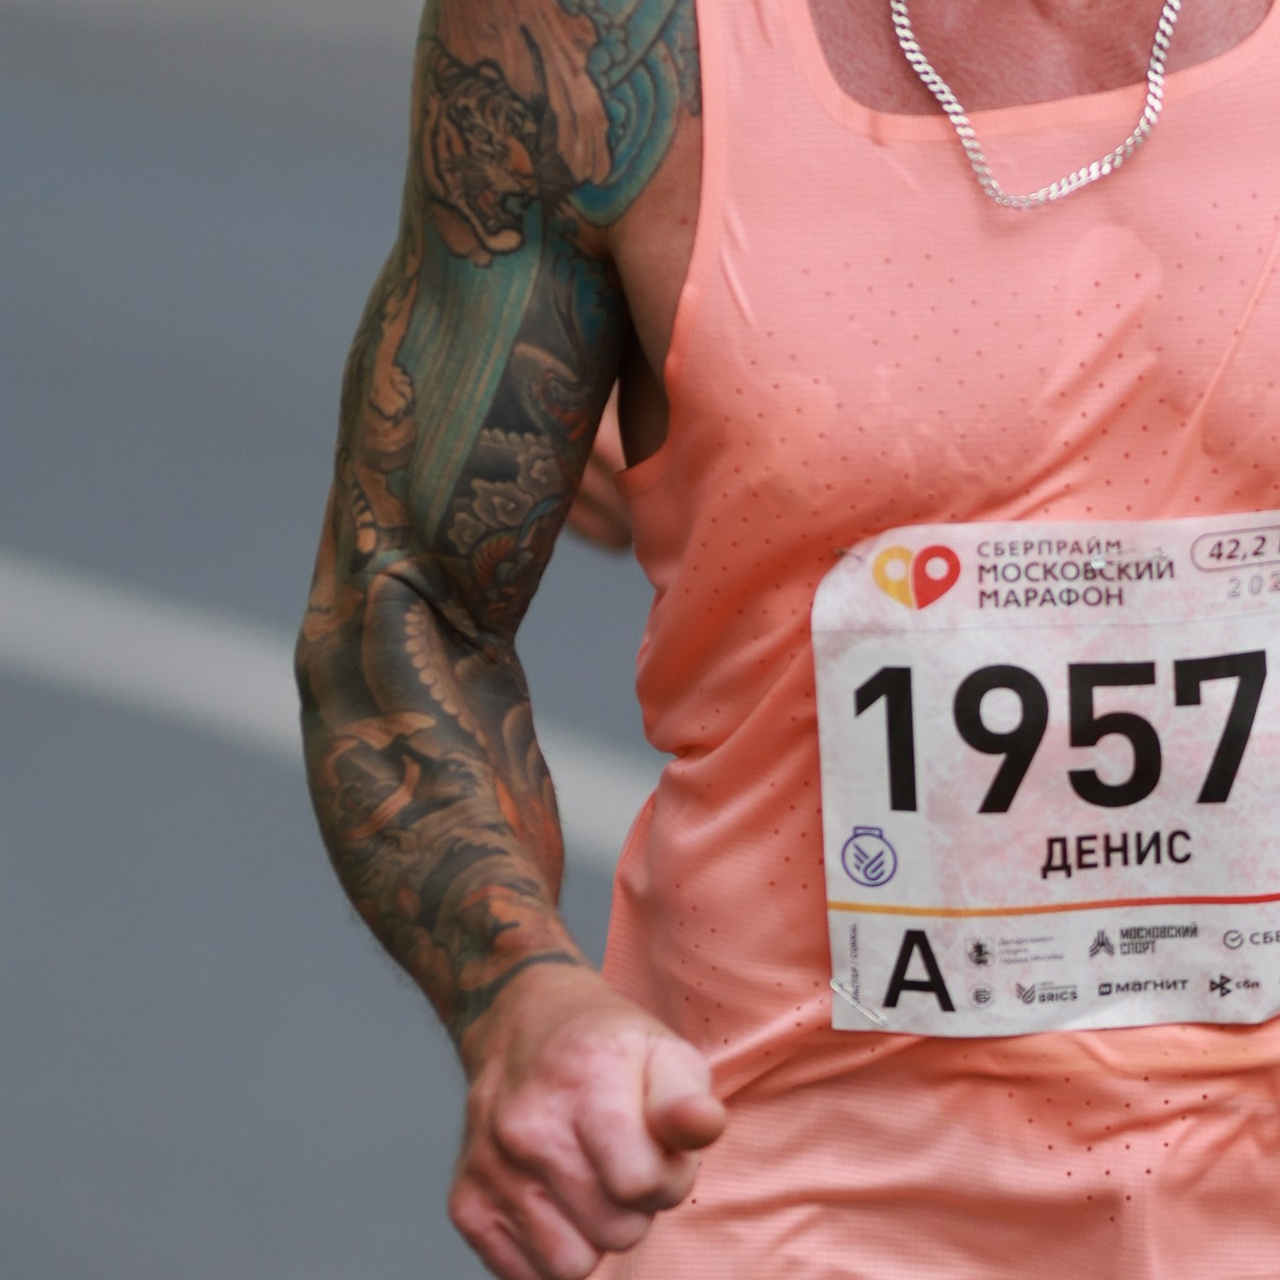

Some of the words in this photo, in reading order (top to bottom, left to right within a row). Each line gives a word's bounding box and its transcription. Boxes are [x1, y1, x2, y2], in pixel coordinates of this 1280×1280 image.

[977, 536, 1122, 558] СБЕРПРАЙМ
[1209, 535, 1266, 560] 42,2
[978, 557, 1175, 583] МОСКОВСКИЙ
[979, 586, 1123, 608] МАРАФОН
[1041, 829, 1192, 879] ДЕНИС
[1120, 922, 1198, 940] МОСКОВСКИЙ
[1120, 940, 1156, 955] СПОРТ
